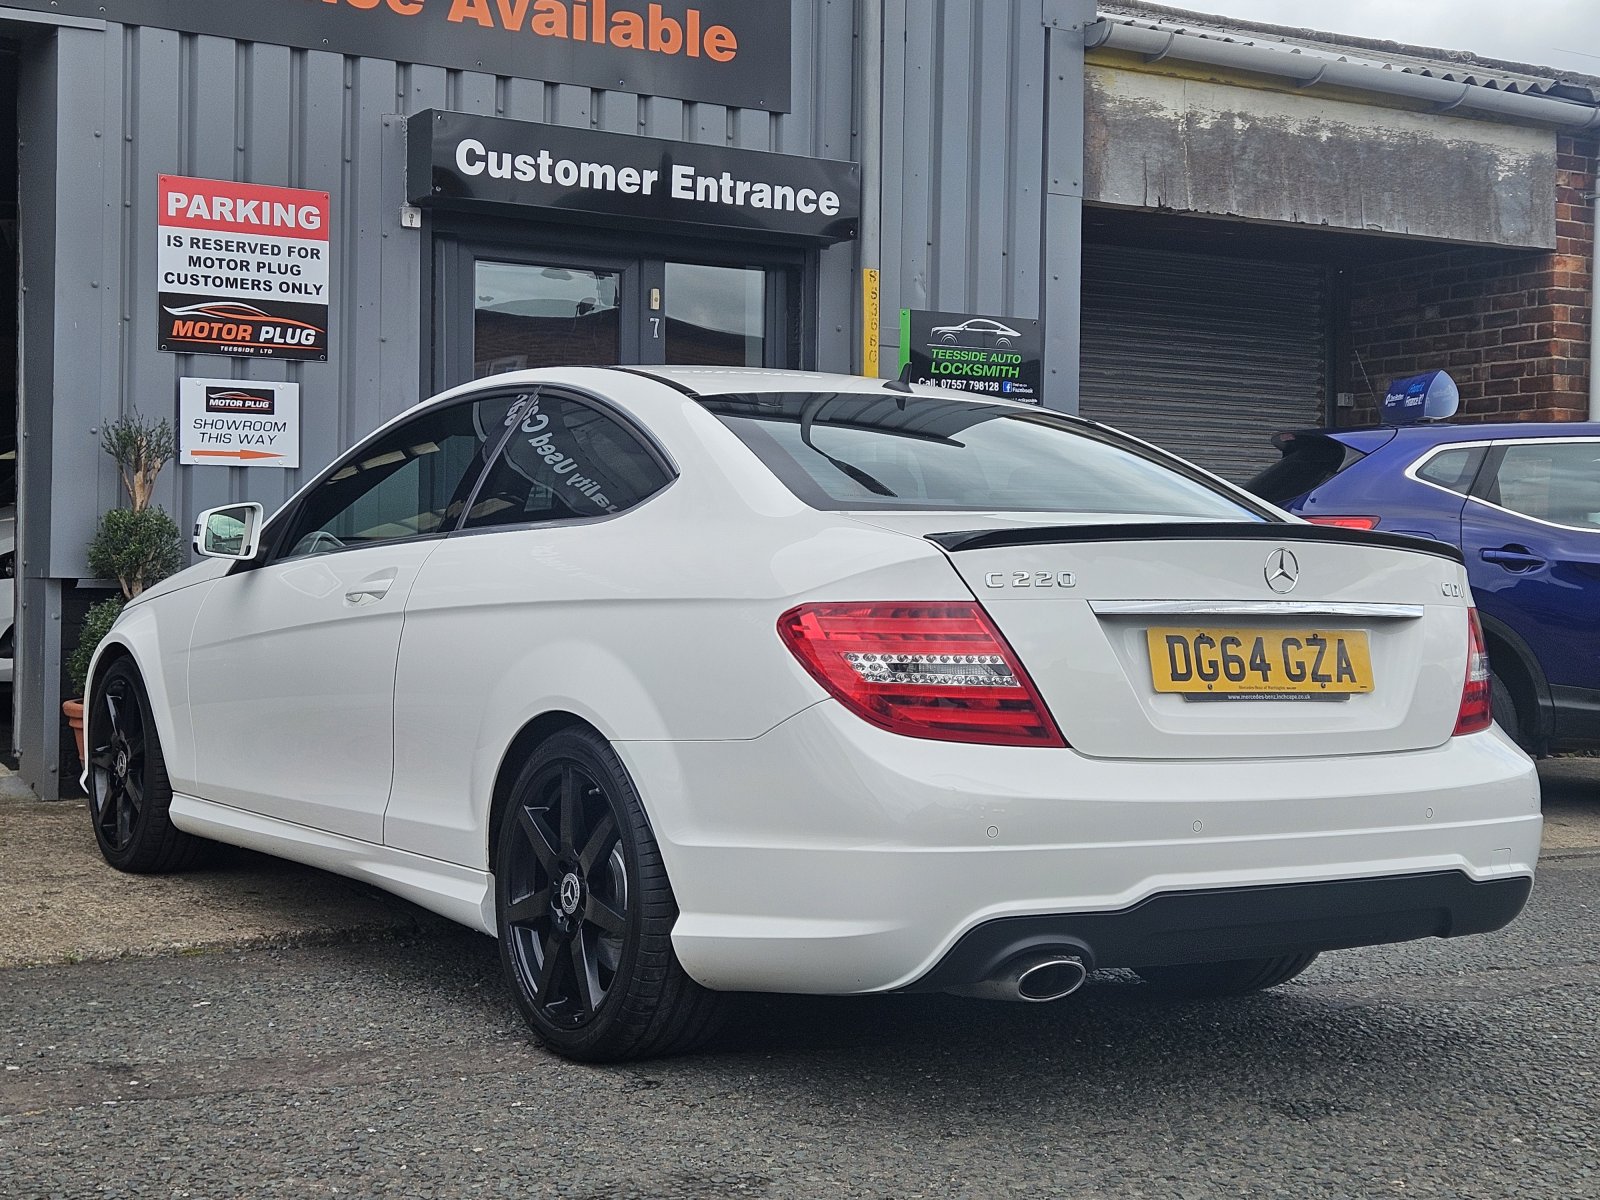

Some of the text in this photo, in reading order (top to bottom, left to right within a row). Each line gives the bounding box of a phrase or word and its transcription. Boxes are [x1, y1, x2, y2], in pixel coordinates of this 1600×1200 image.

[447, 0, 738, 62] Available
[456, 139, 840, 216] Customer Entrance
[168, 191, 321, 230] PARKING
[166, 235, 321, 260] IS RESERVED FOR
[188, 255, 302, 276] MOTOR PLUG
[163, 272, 323, 296] CUSTOMERS ONLY
[172, 320, 316, 345] MOTOR PLUG
[649, 317, 660, 338] 7
[220, 345, 254, 353] TEESSIDE
[931, 349, 1021, 364] TEESSIDE AUTO
[931, 362, 1020, 378] LOCKSMITH
[918, 377, 999, 391] Call: 07557 798128
[209, 399, 269, 408] MOTOR PLUG
[193, 418, 287, 432] SHOWROOM
[199, 432, 278, 446] THIS WAY
[985, 570, 1076, 588] C 220
[1441, 582, 1464, 598] CDI
[1165, 634, 1357, 683] DG64 GZA
